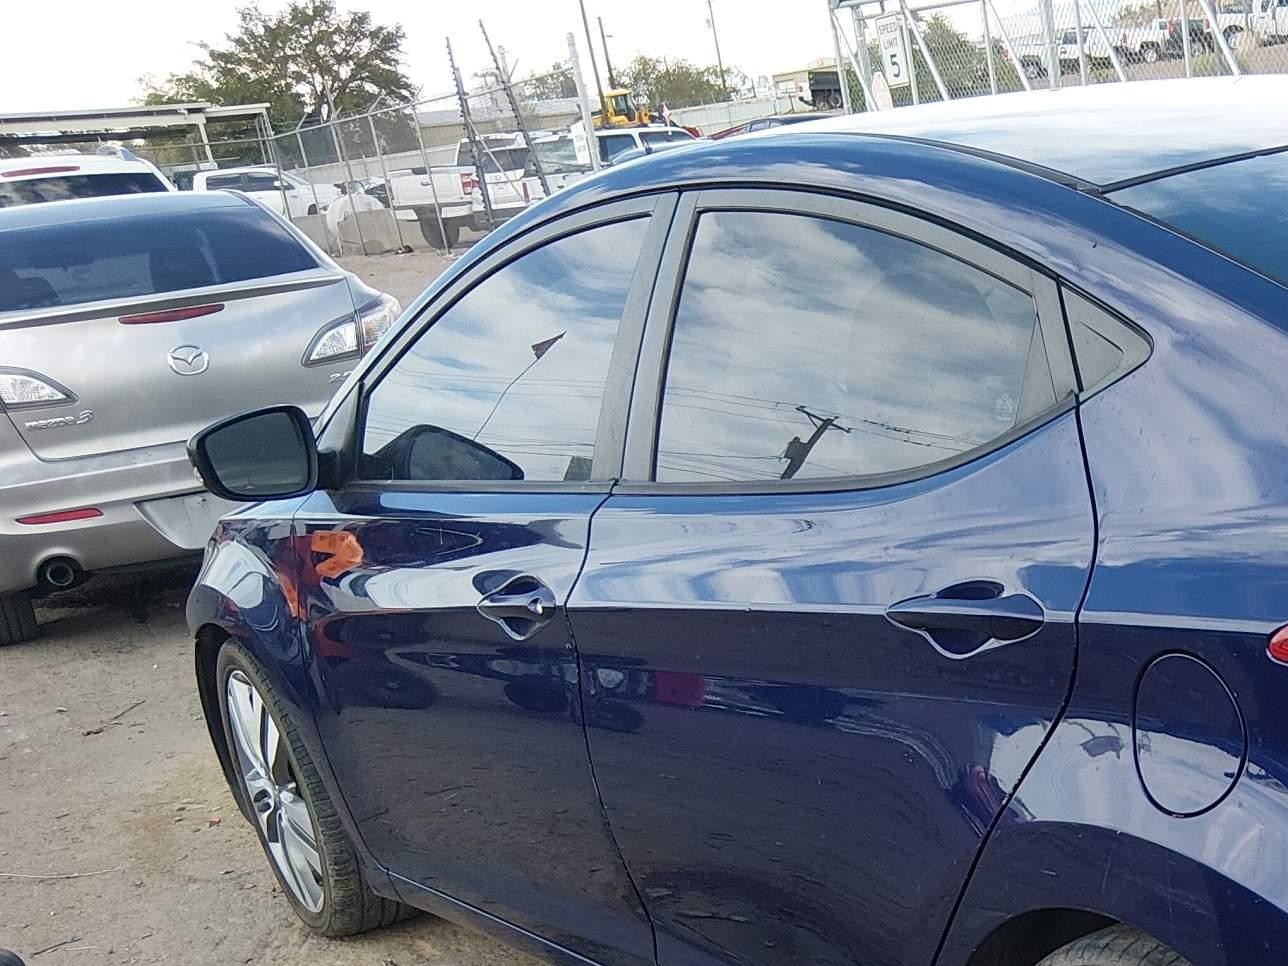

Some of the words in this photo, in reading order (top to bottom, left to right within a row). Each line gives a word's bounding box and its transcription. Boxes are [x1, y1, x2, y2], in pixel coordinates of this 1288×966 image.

[879, 22, 898, 35] SPEED
[883, 38, 898, 50] LIMIT
[890, 53, 901, 78] 5
